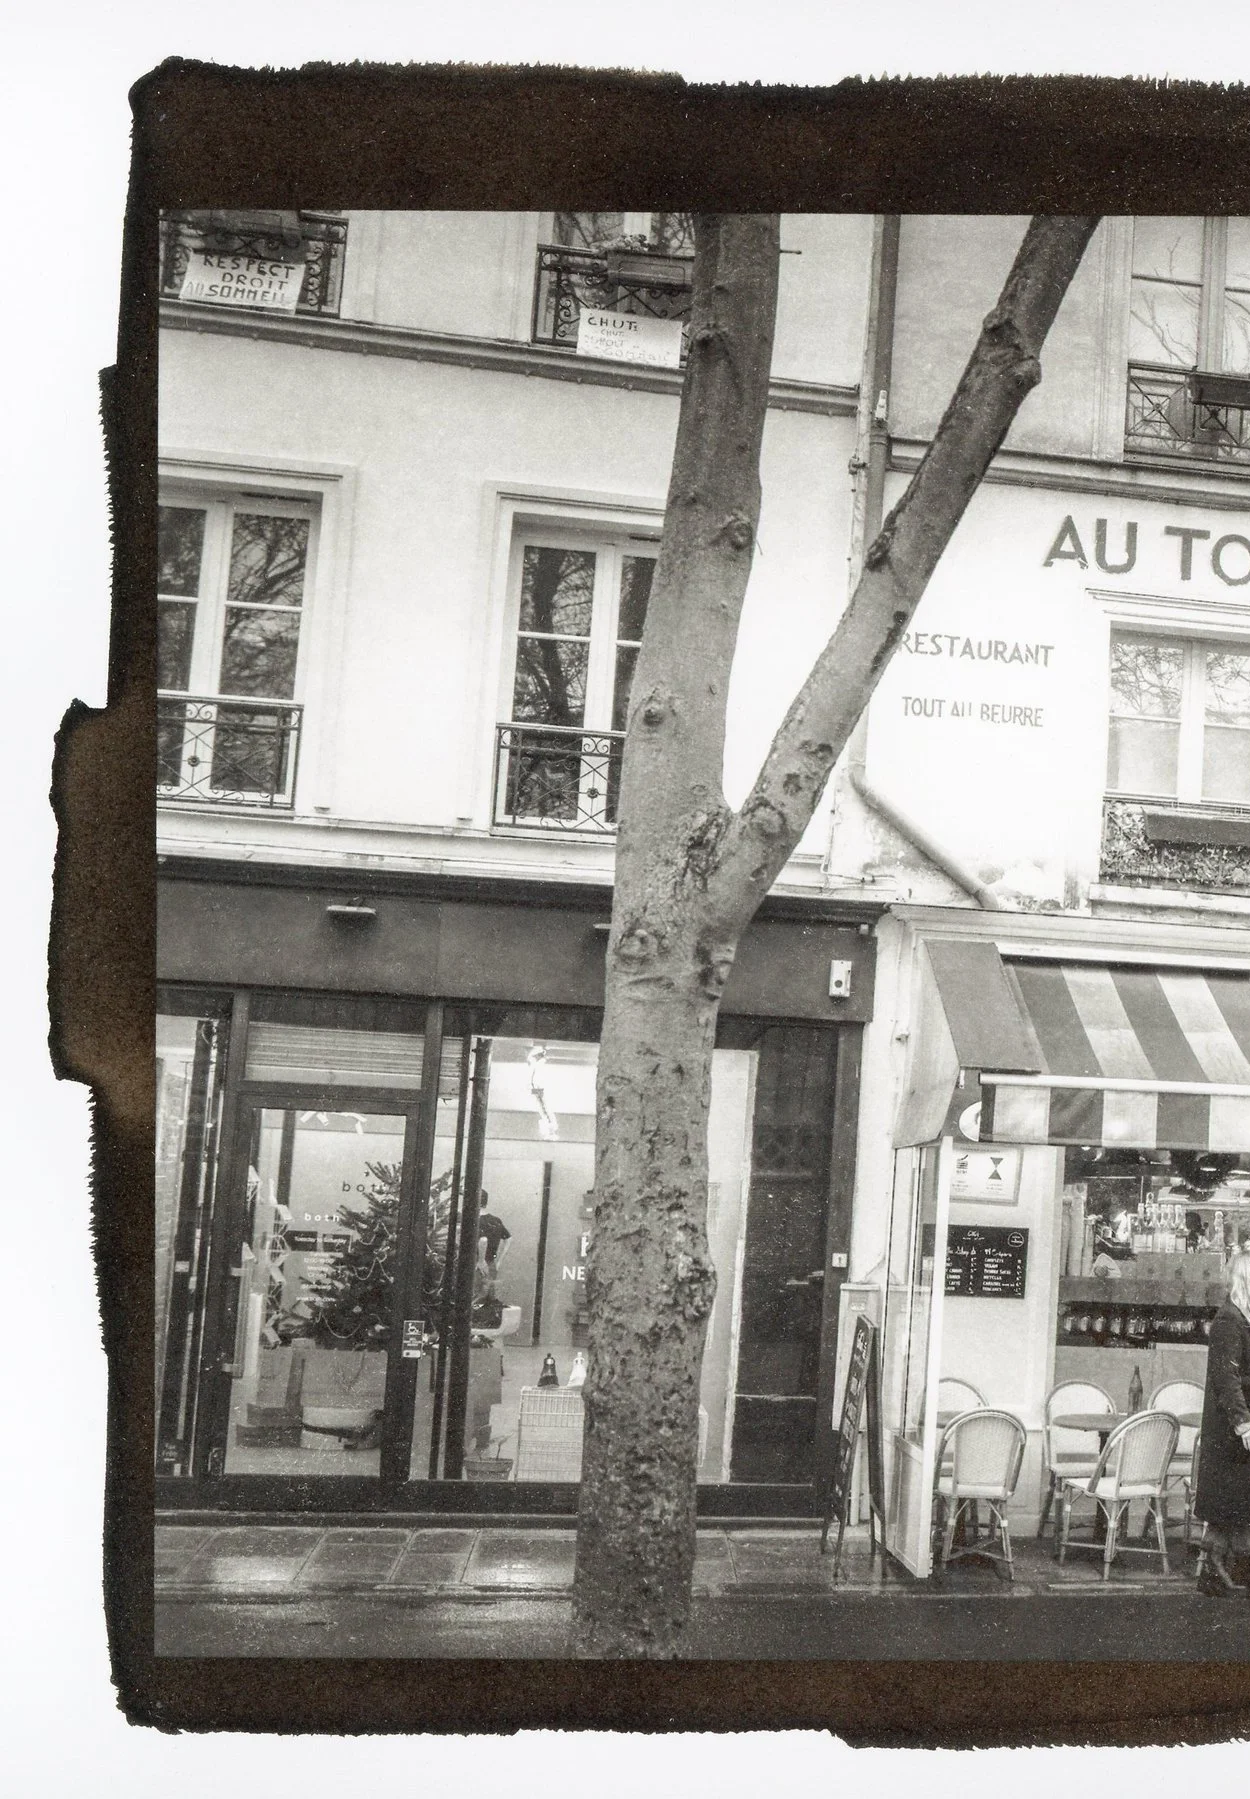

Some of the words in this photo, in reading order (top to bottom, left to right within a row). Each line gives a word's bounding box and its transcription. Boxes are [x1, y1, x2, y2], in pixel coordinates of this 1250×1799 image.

[203, 254, 296, 279] RESPECT
[222, 272, 289, 290] DROIT
[1043, 515, 1138, 574] AU
[900, 631, 1055, 668] RESTAURANT
[901, 696, 946, 718] TOUT
[979, 702, 1044, 728] BEURRE
[342, 1181, 386, 1193] bot
[304, 1212, 340, 1222] both
